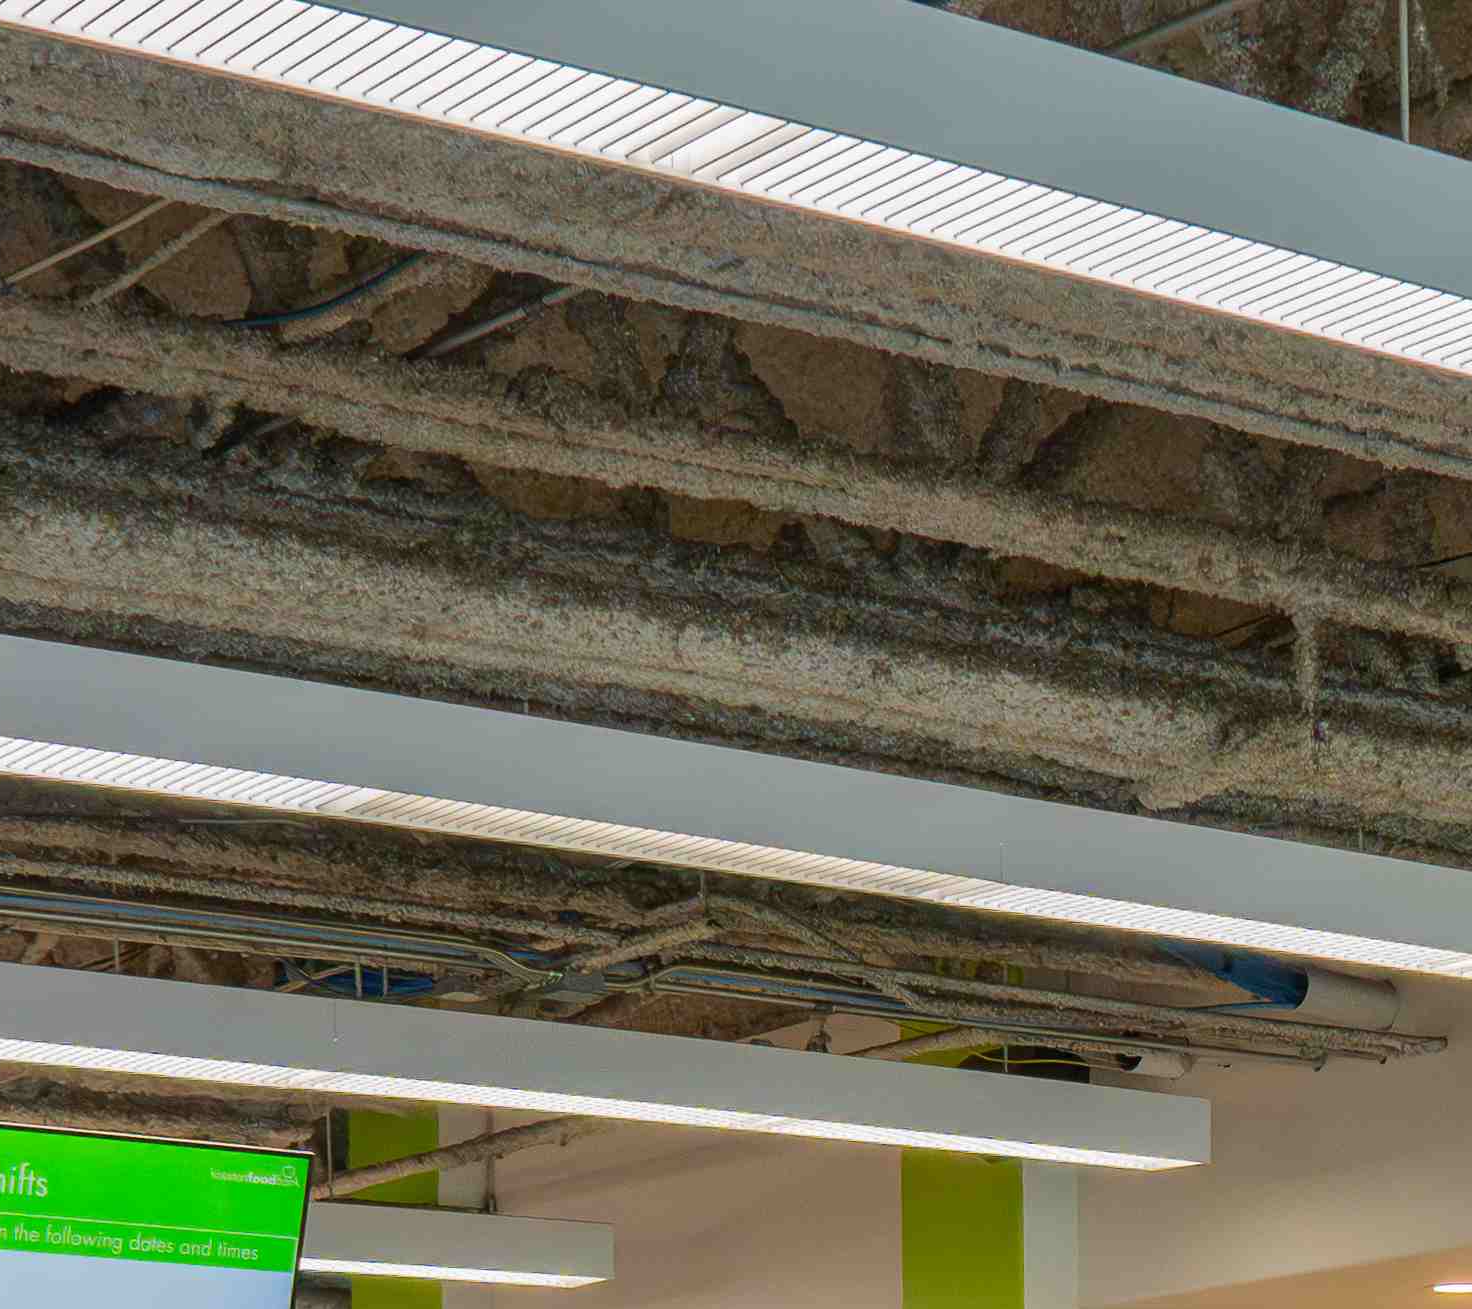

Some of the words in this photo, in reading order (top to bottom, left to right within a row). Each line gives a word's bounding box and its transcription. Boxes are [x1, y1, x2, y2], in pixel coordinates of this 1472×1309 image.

[14, 1222, 40, 1243] the
[45, 1225, 123, 1255] following
[129, 1231, 175, 1254] dates
[180, 1236, 213, 1257] and
[217, 1239, 259, 1260] times
